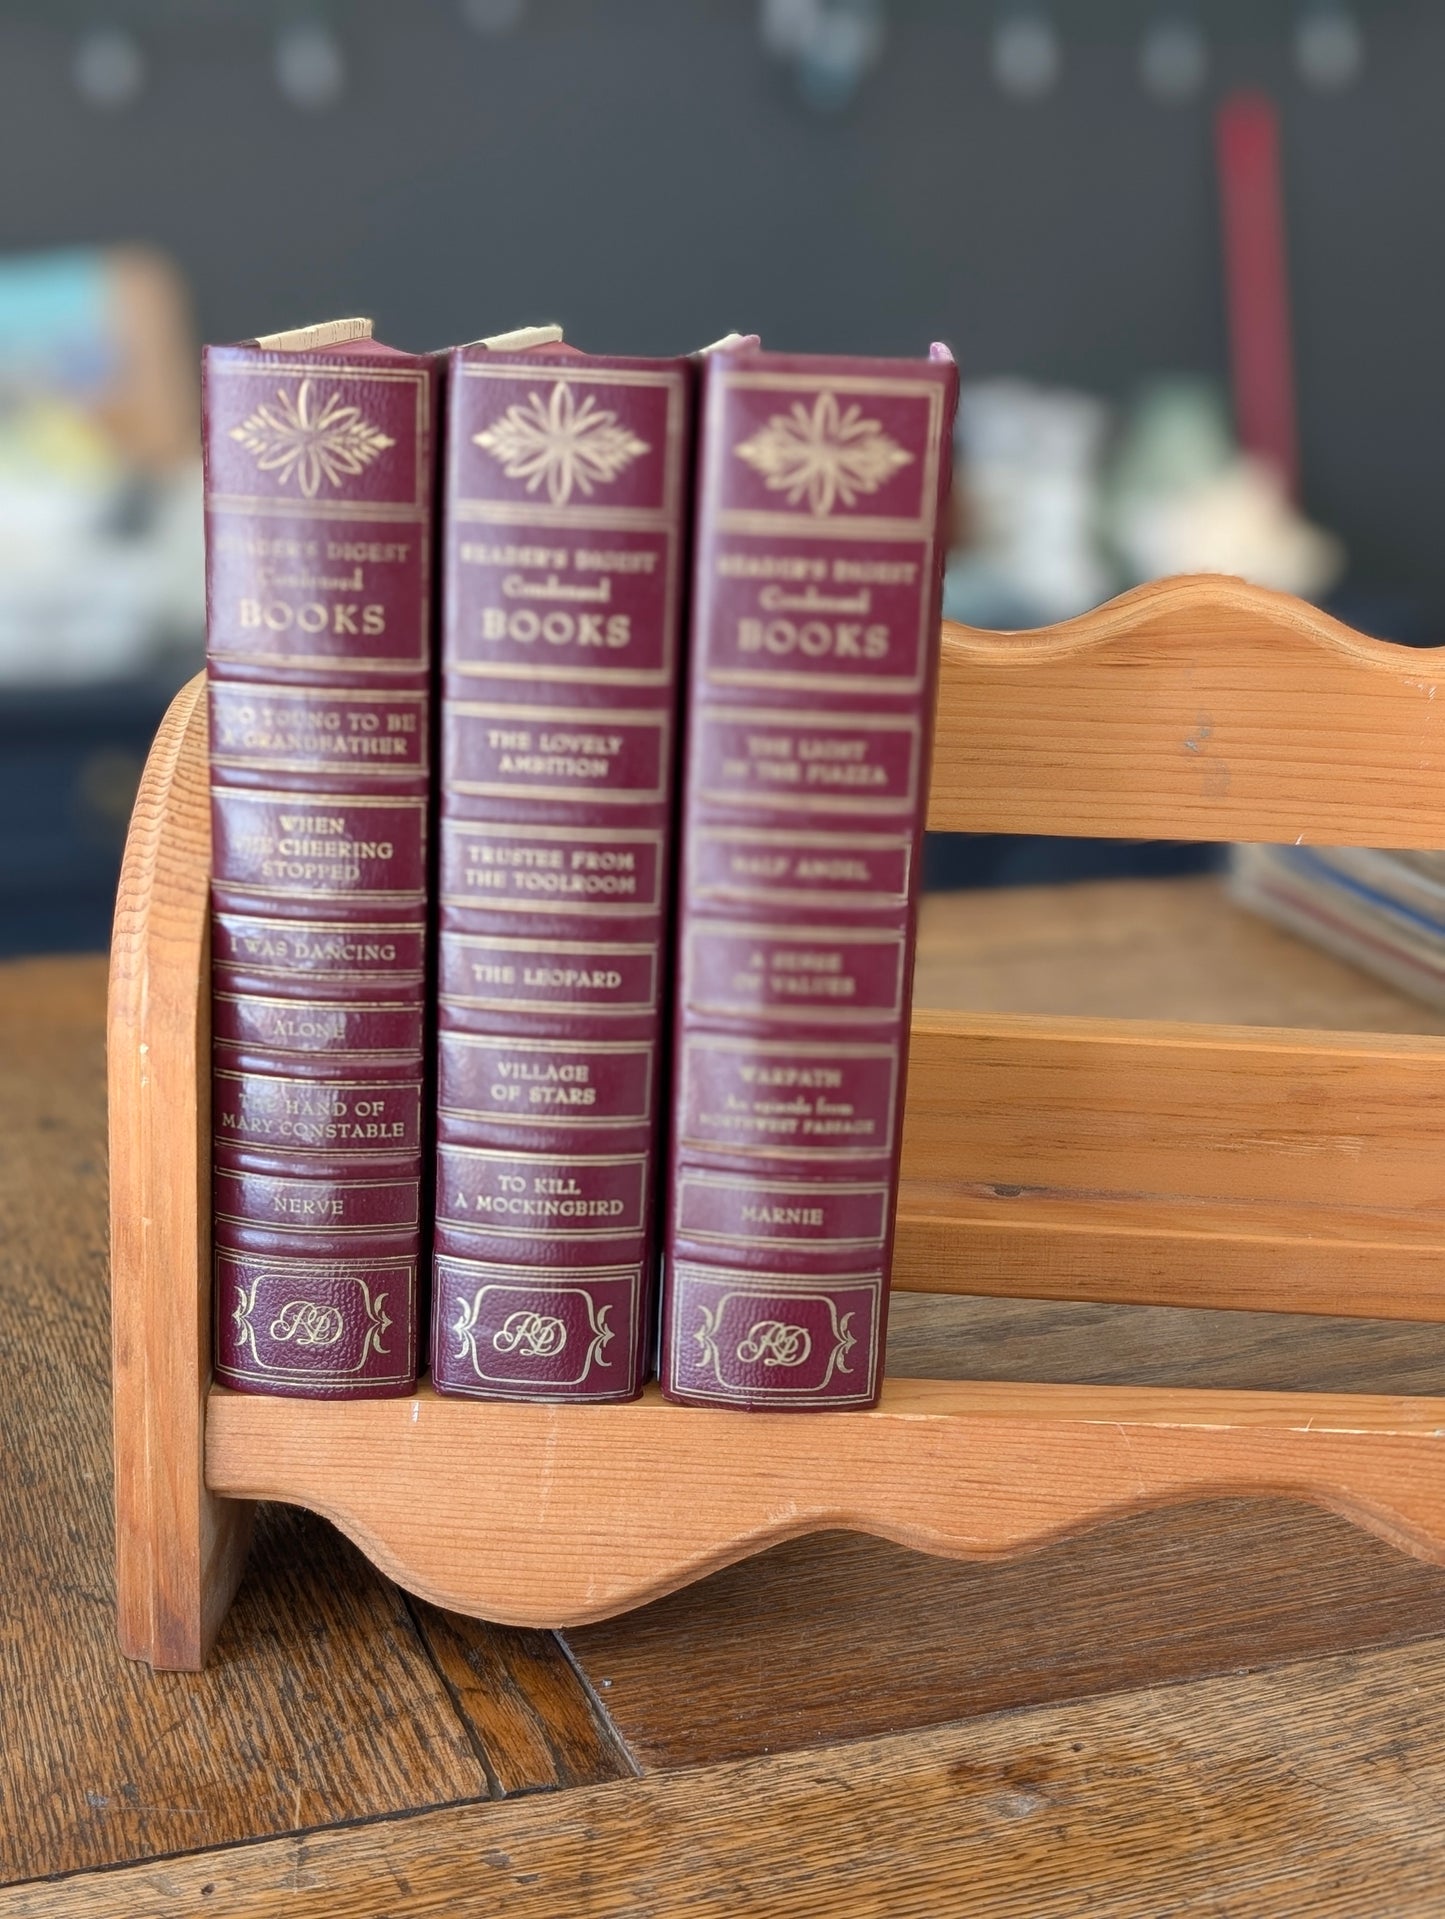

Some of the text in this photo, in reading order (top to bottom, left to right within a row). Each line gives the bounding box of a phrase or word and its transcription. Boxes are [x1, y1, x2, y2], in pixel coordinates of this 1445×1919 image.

[215, 537, 409, 563] ADER'S DIGEST
[239, 598, 386, 635] BOOKS
[482, 607, 631, 648] BOOKS
[738, 617, 890, 660] BOOKS
[262, 708, 340, 731] YOUNG
[347, 712, 379, 732] TO
[387, 714, 416, 733] BE
[244, 731, 407, 755] GRANDFATHER
[487, 730, 622, 755] THE LOVELY
[747, 736, 791, 757] THE
[499, 755, 608, 777] AMBITION
[755, 761, 800, 782] THE
[279, 815, 344, 834] WHEN
[279, 838, 393, 859] CHEERING
[468, 845, 634, 871] TRUSTEE FROM
[262, 860, 360, 880] STOPPED
[465, 869, 635, 894] THE TOOLROOM
[230, 937, 395, 961] I WAS DANCING
[751, 952, 764, 971] A
[472, 964, 622, 988] THE LEOPARD
[274, 1020, 345, 1039] ALONE
[498, 1062, 589, 1082] VILLAGE
[739, 1066, 842, 1087] WARPATH
[238, 1093, 385, 1117] THE HAND OF
[490, 1085, 596, 1105] OF STARS
[816, 1096, 853, 1115] from
[222, 1113, 404, 1138] MARY CONSTABLE
[498, 1176, 581, 1195] TO KILL
[274, 1197, 344, 1215] NERVE
[455, 1193, 624, 1216] A MOCKINGBIRD
[741, 1206, 824, 1226] MARNIE
